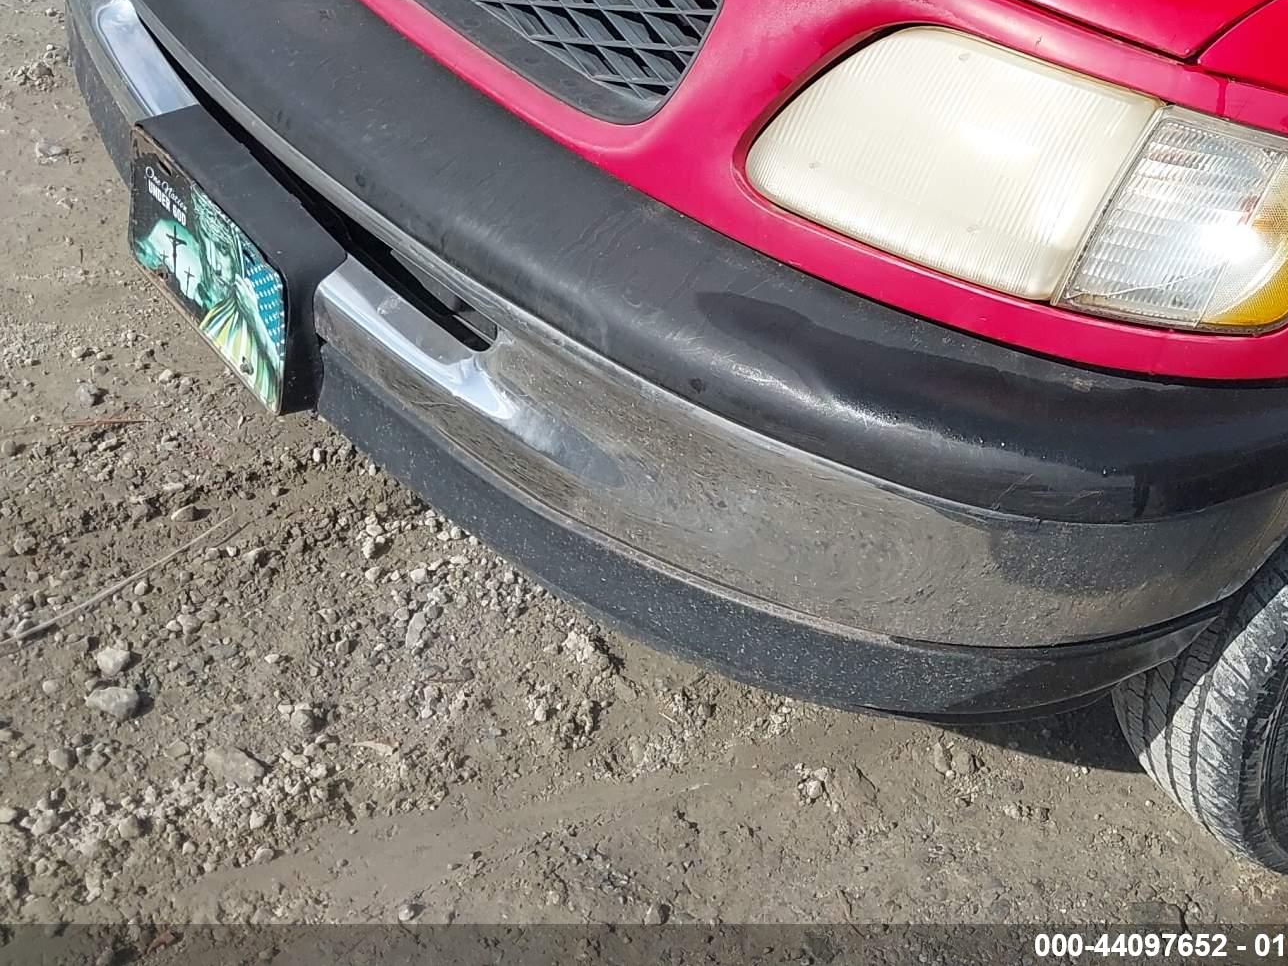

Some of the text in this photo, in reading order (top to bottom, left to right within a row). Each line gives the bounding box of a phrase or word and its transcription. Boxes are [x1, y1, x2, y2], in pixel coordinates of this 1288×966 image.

[145, 166, 161, 186] One
[148, 179, 187, 227] UNDER GOD
